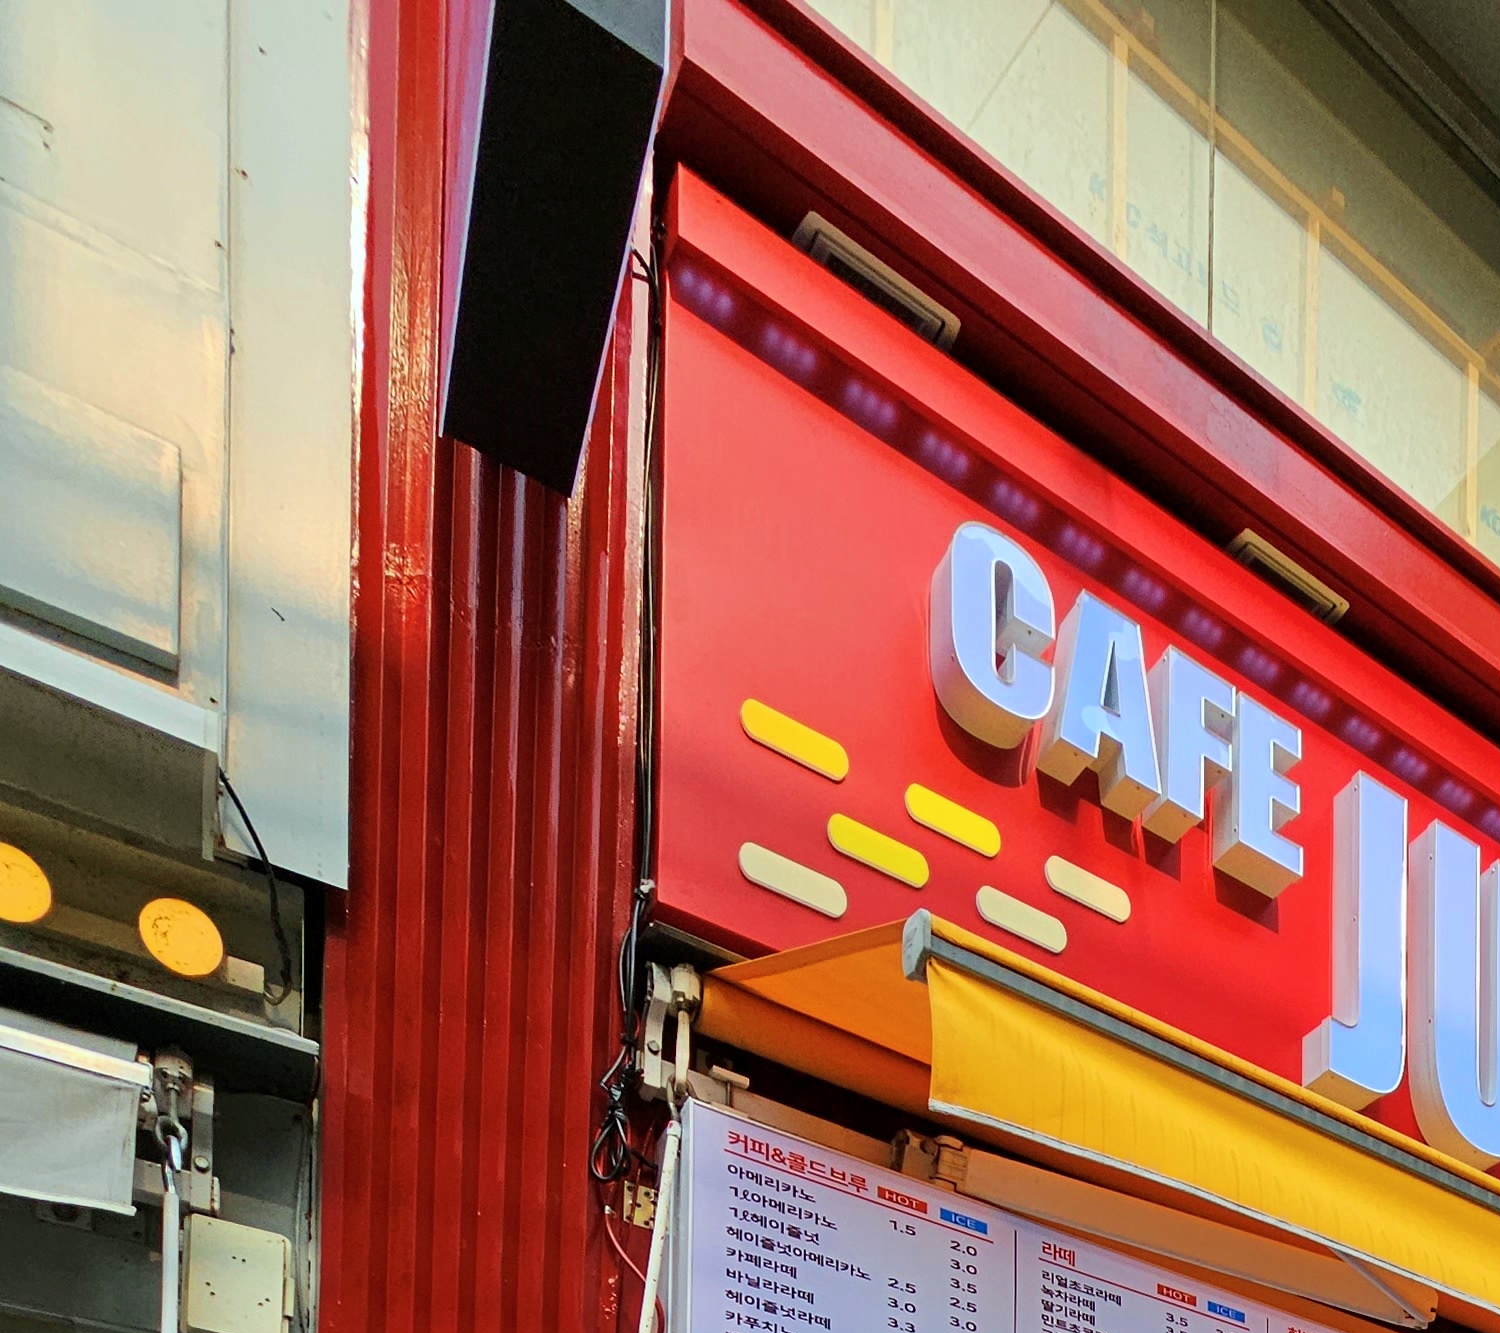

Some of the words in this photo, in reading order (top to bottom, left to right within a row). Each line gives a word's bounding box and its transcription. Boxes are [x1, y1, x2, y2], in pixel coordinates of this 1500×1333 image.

[935, 520, 1304, 892] CAFE
[727, 1164, 816, 1203] 아메리카노
[889, 1220, 916, 1237] 1.5
[950, 1240, 978, 1257] 2.0
[728, 1130, 868, 1193] 커피&콜드브루
[885, 1190, 919, 1209] HOT
[950, 1214, 976, 1229] ICE
[725, 1268, 814, 1305] 바닐라라떼
[726, 1247, 798, 1280] 카페라떼
[1041, 1270, 1122, 1307] 리얼초코라떼
[1042, 1241, 1076, 1267] 라떼
[1163, 1287, 1190, 1303] HOT
[1216, 1305, 1237, 1319] ICE
